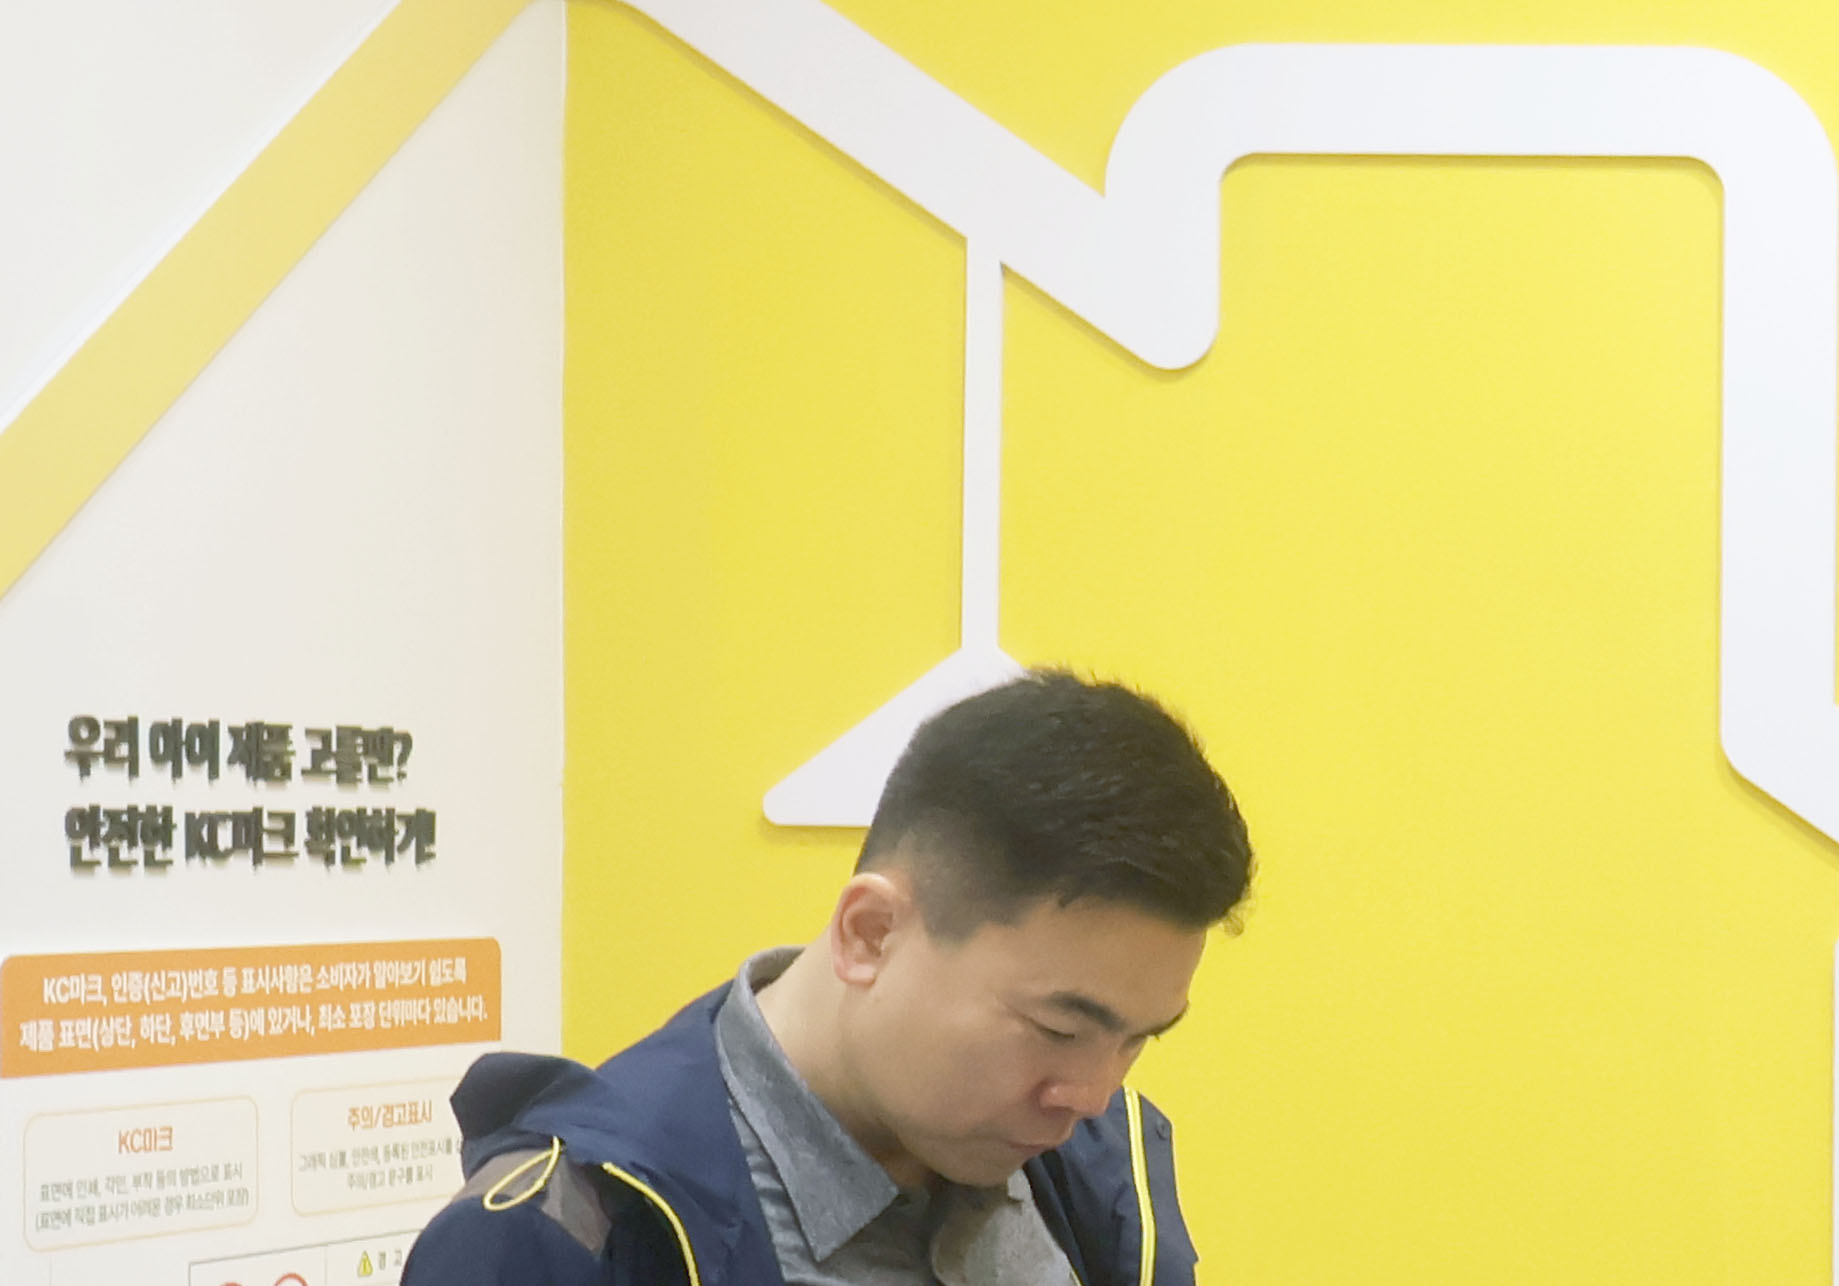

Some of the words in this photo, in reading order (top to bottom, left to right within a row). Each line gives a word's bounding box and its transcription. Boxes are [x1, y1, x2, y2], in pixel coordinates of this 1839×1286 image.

[64, 714, 139, 782] 우리
[149, 717, 220, 784] 아이
[227, 721, 296, 784] 제품
[65, 803, 177, 870] 안전한
[184, 806, 299, 868] KC마크
[43, 973, 108, 1007] KC마크,
[111, 967, 219, 1005] 인증(신고)번호
[222, 965, 238, 998] 등
[241, 963, 313, 995] 표시사항은
[315, 961, 371, 992] 소비자가
[373, 958, 427, 990] 알아보기
[429, 956, 468, 987] 쉽도록
[19, 1018, 55, 1052] 제품
[228, 1006, 265, 1041] 등)에
[268, 1004, 316, 1037] 있거나,
[318, 1002, 346, 1032] 최소
[349, 1000, 376, 1031] 포장
[378, 996, 431, 1028] 단위마다
[433, 993, 489, 1025] 있습니다.
[117, 1125, 174, 1154] KC마크
